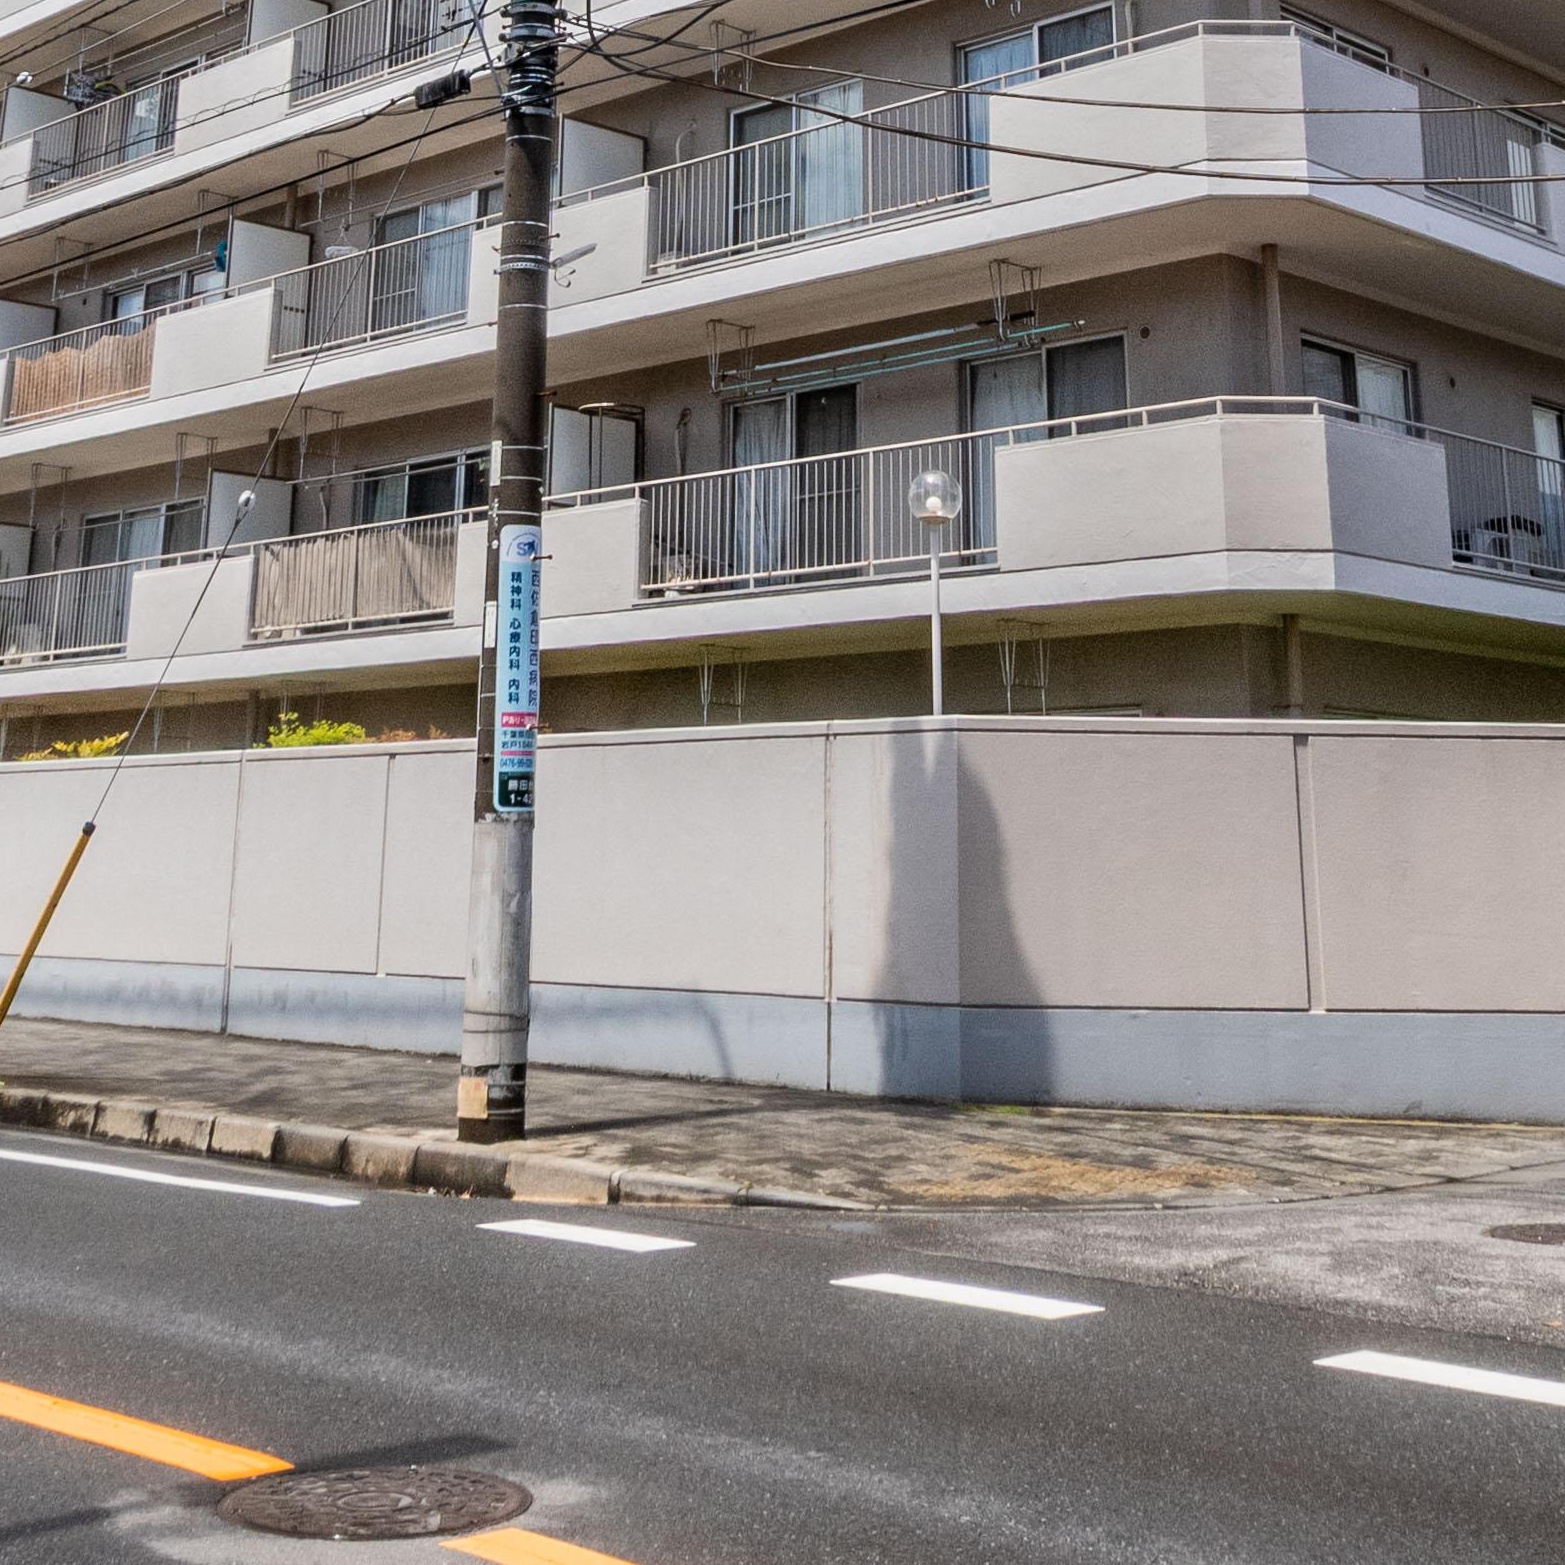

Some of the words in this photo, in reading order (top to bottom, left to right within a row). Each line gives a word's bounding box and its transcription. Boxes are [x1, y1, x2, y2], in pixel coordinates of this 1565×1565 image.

[510, 571, 522, 610] 精神科
[509, 618, 521, 671] 心療内科
[508, 678, 521, 704] 内科
